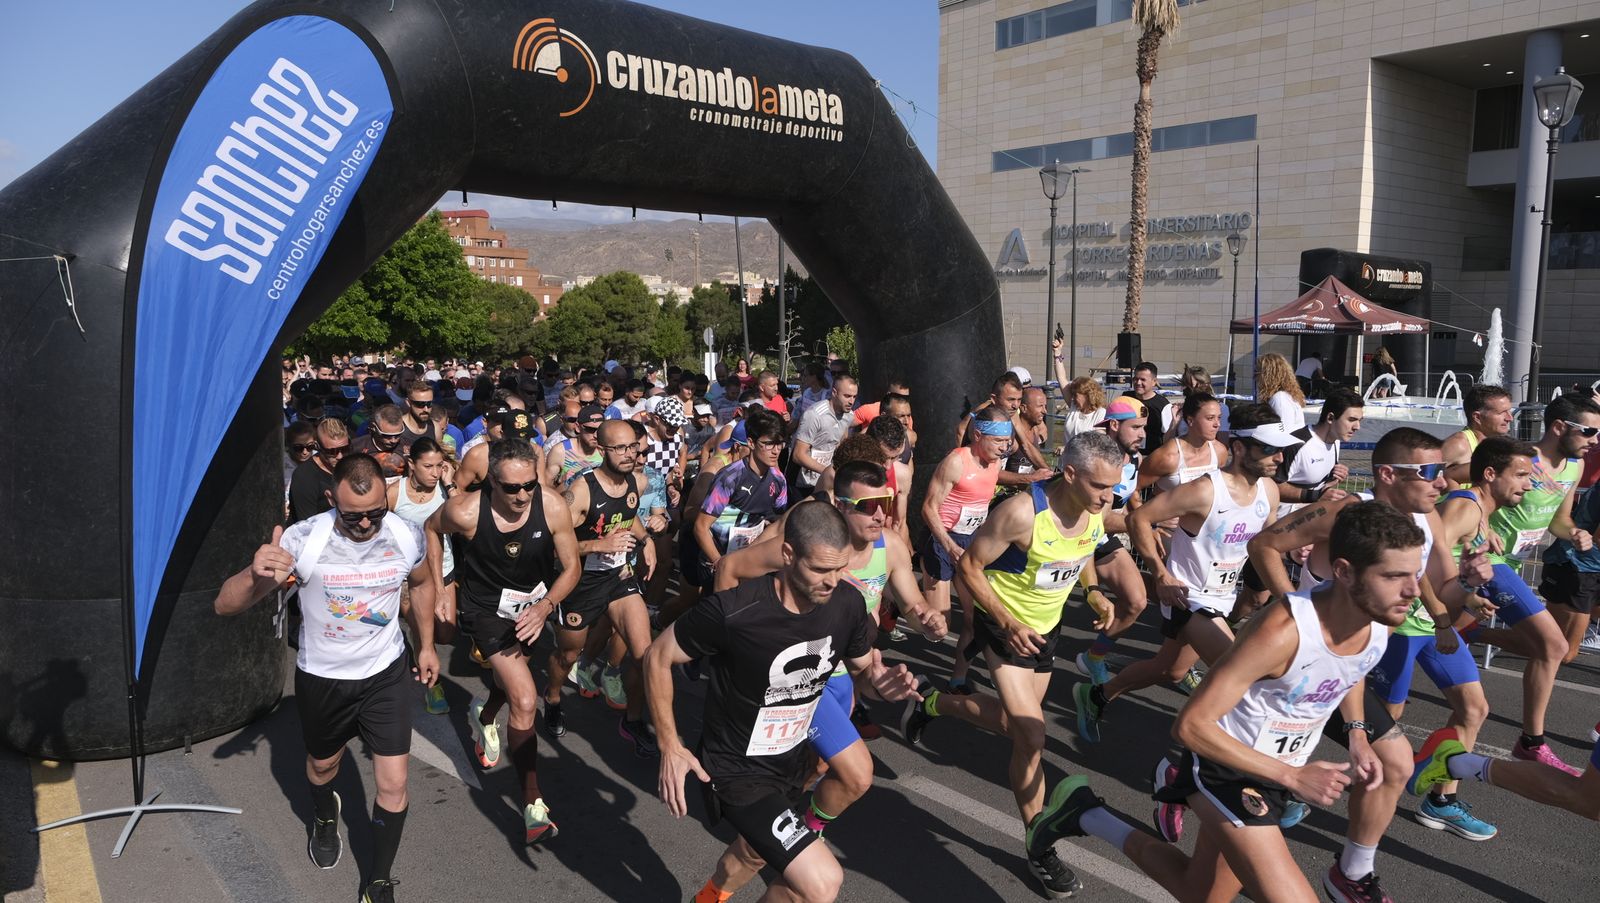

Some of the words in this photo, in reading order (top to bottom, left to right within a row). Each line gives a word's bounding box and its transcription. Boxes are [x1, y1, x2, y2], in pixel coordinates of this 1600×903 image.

[690, 108, 783, 134] cronometraje
[785, 120, 844, 142] deportivo
[267, 119, 384, 300] centrohogarsanchez.es
[611, 513, 622, 524] GO
[1232, 523, 1246, 533] GO
[1050, 564, 1081, 583] 109
[1316, 678, 1341, 693] GO
[1274, 731, 1313, 754] 161
